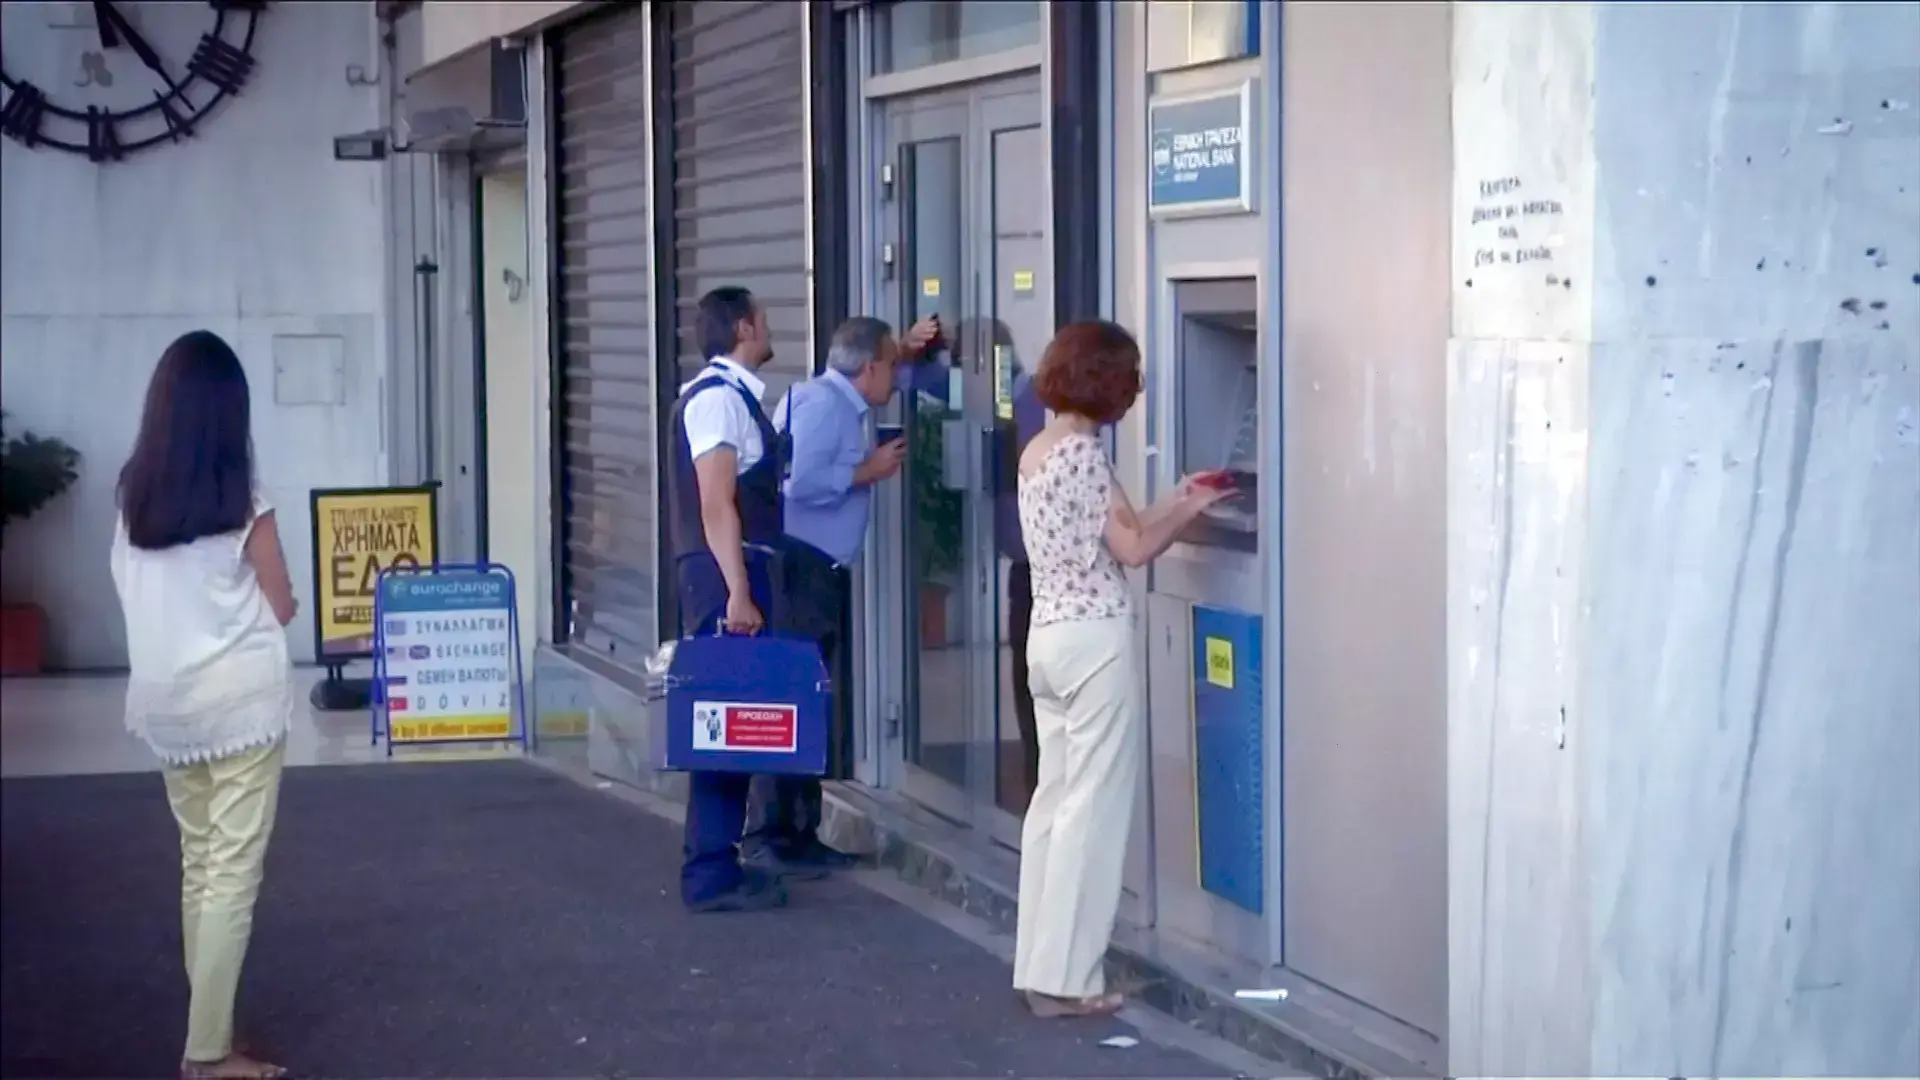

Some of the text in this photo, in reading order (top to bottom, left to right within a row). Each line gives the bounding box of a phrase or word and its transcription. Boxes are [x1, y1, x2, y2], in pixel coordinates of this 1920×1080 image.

[1173, 151, 1211, 170] NATIONAL
[1212, 147, 1235, 167] BANK
[333, 523, 420, 552] ΧΡΗΜΑΤΑ
[410, 580, 500, 596] eurochange
[416, 617, 506, 634] ΣΥΝΑΛΛΑΓΜΑ
[436, 642, 507, 659] EXCHANGE
